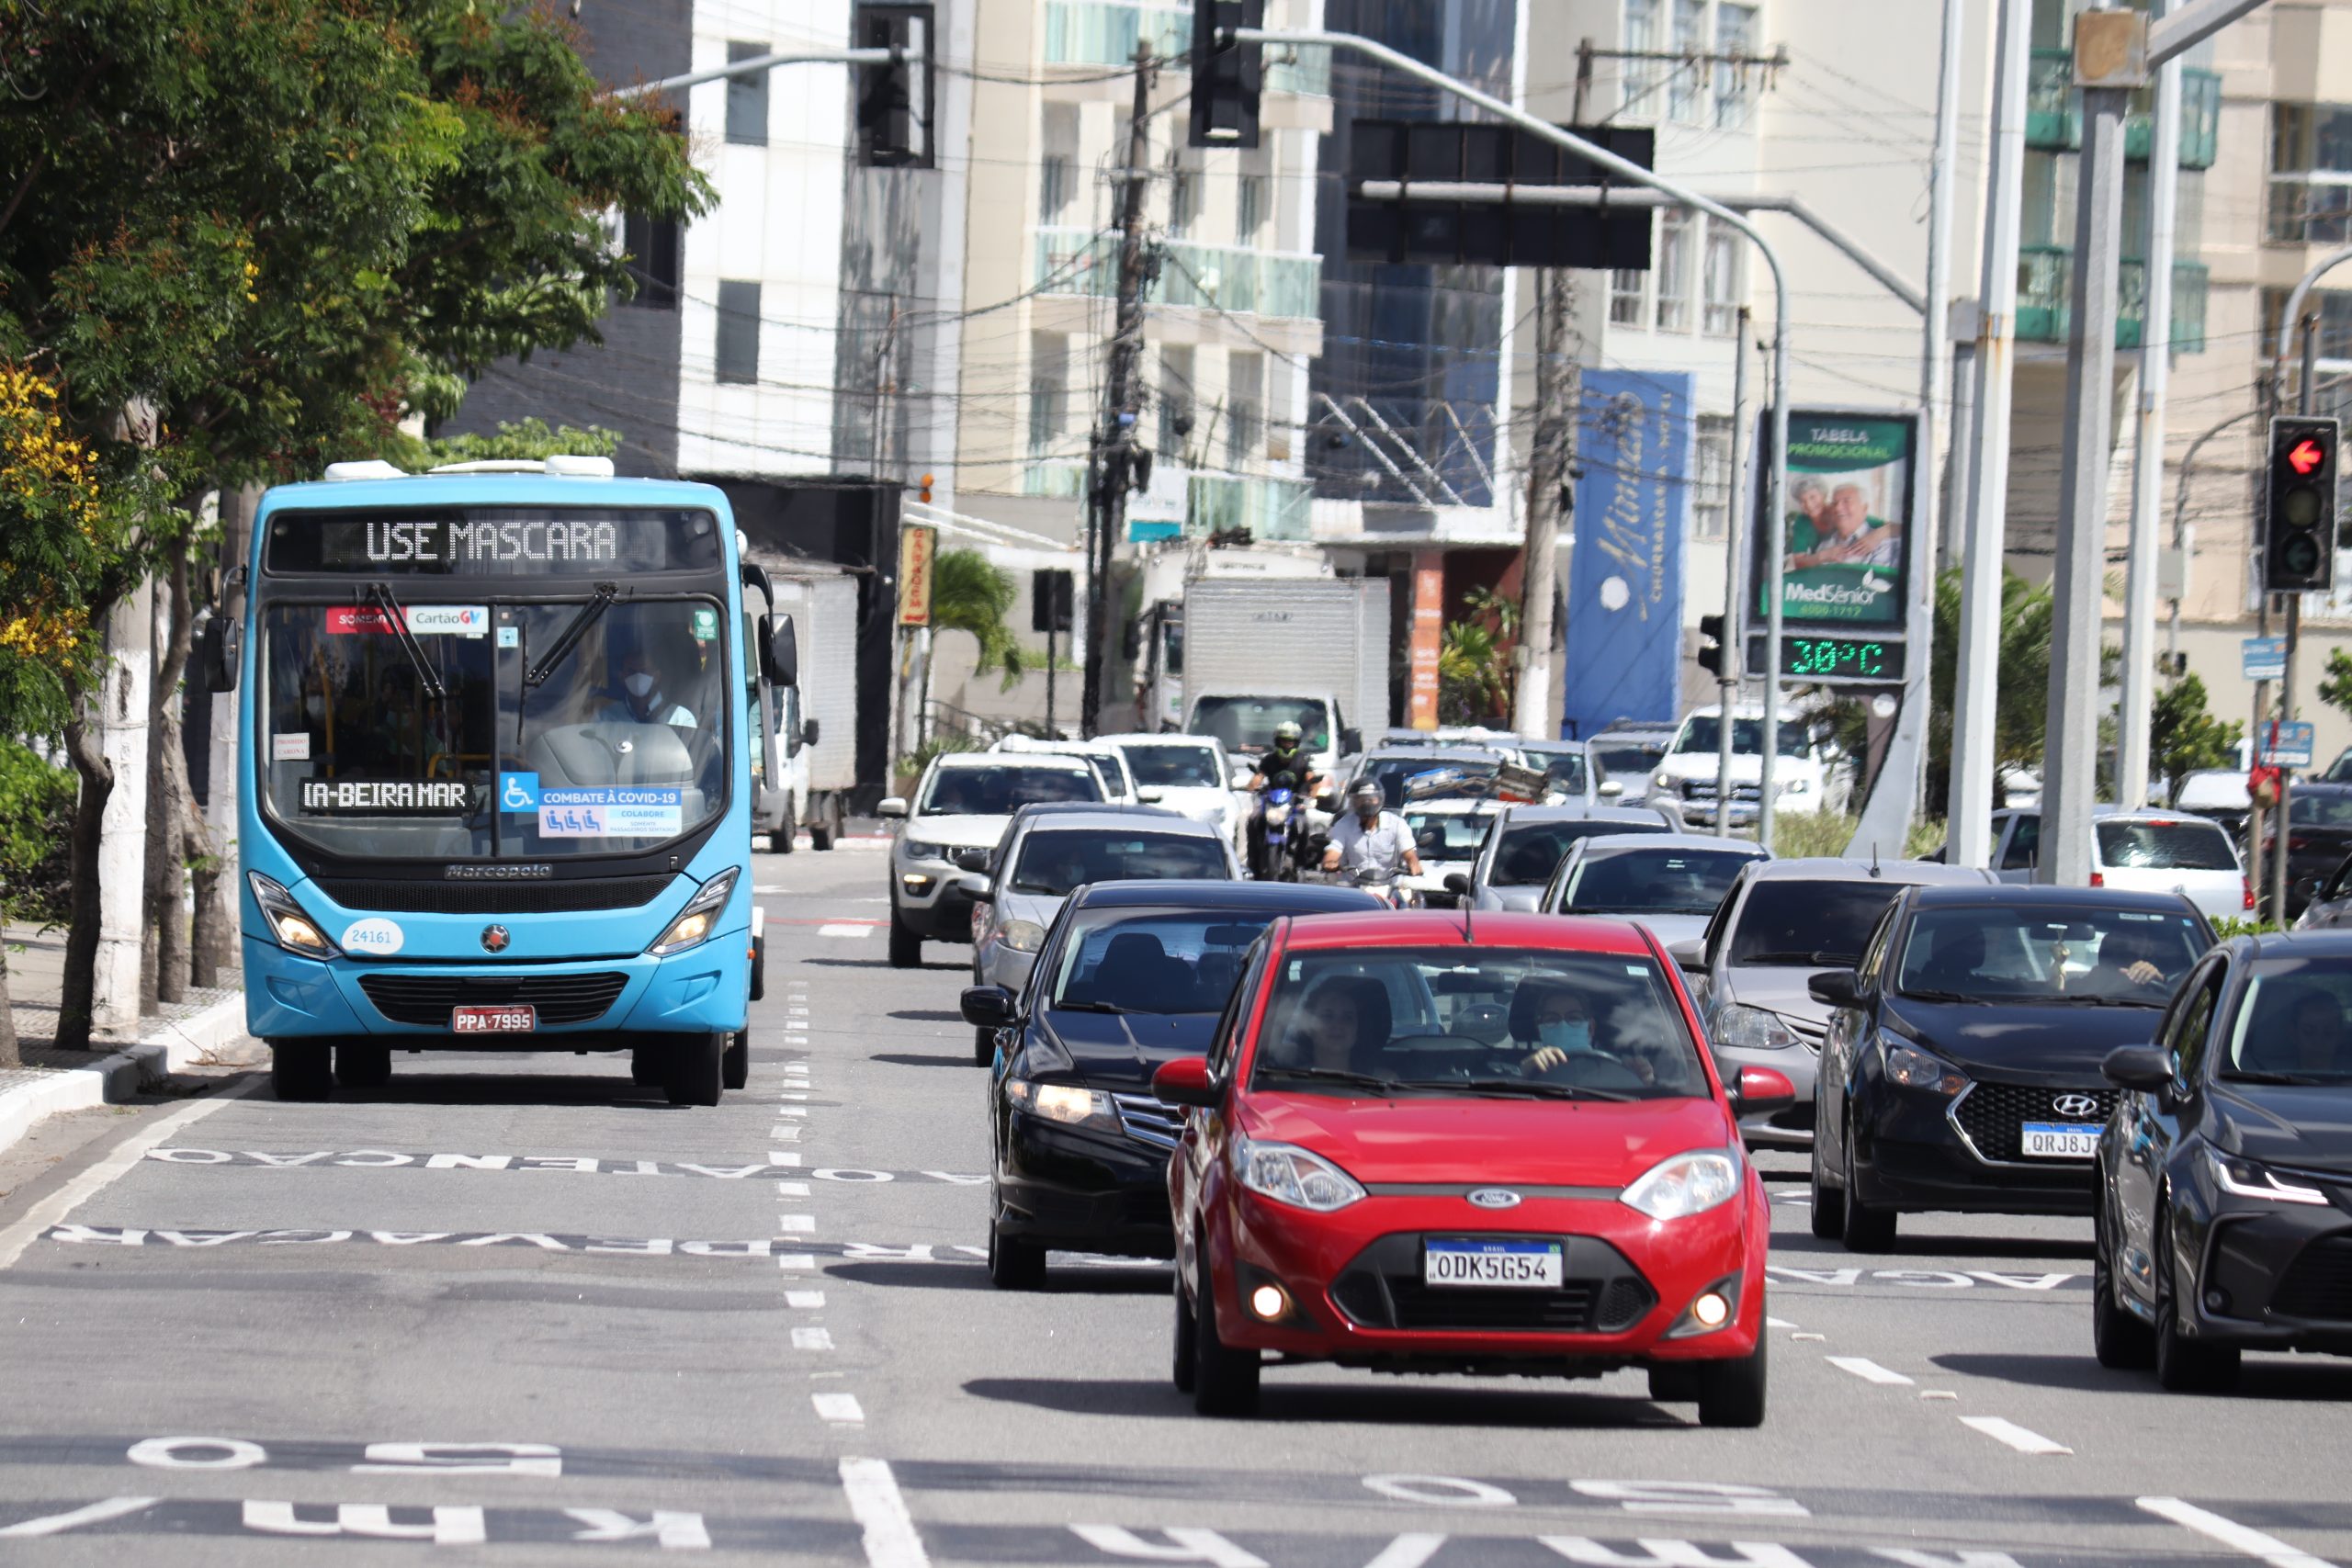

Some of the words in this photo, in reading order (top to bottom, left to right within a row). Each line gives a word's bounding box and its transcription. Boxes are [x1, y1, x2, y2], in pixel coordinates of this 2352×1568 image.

[1810, 427, 1870, 444] TABELA
[1788, 443, 1892, 459] PROMOCIONAL
[367, 522, 438, 560] USE
[448, 522, 616, 560] MASCARA
[910, 528, 925, 608] GARAGEM
[417, 783, 466, 807] MAR
[544, 793, 605, 804] COMBATE
[606, 789, 616, 804] À
[617, 792, 676, 804] COVID-19
[447, 864, 550, 878] Marcopolo
[352, 930, 391, 943] 24161
[50, 1224, 772, 1257] DEVAGAR
[126, 1436, 562, 1478] 50
[1363, 1472, 1812, 1517] 50
